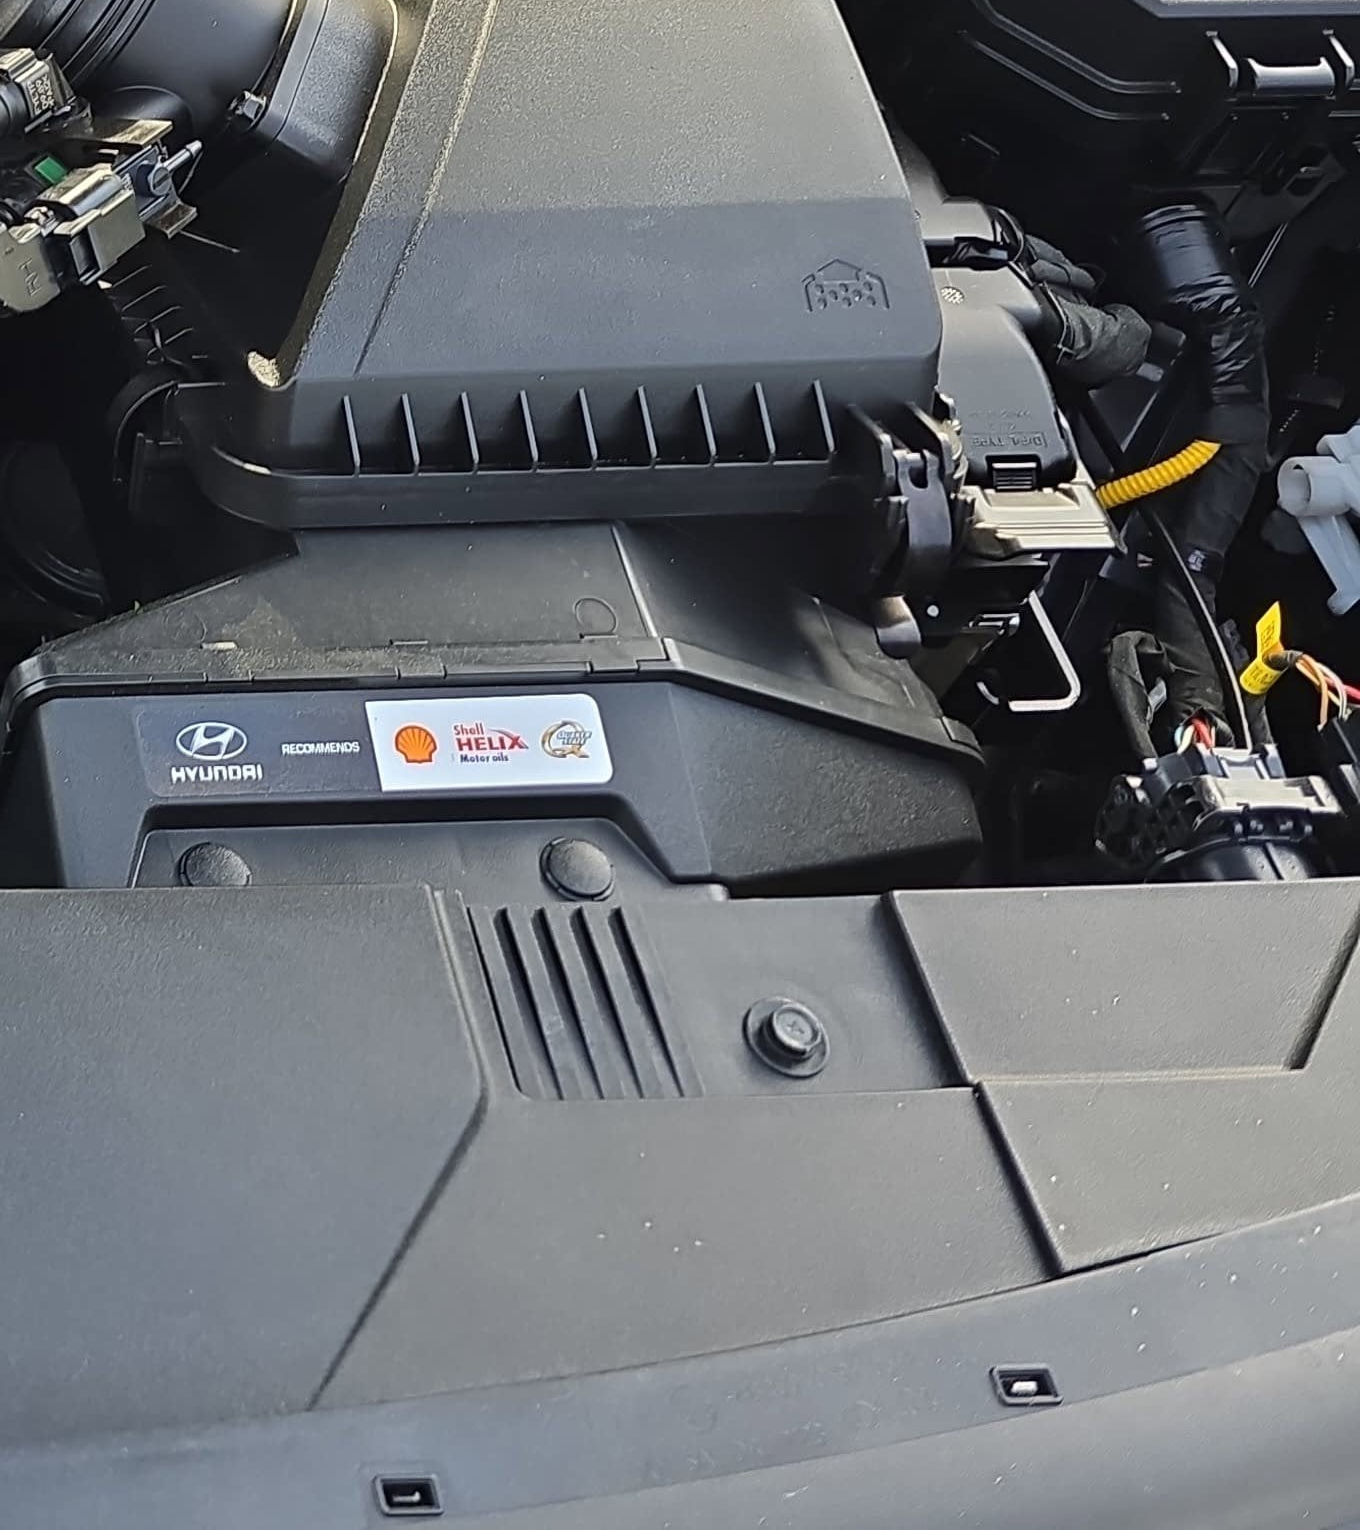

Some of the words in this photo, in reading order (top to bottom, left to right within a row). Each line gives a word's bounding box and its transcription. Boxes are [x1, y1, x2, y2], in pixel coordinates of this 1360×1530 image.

[453, 722, 484, 736] Shell
[282, 741, 361, 757] RECOMMENDS
[457, 735, 528, 751] HELIX
[460, 752, 490, 764] Motor
[492, 753, 509, 763] oils
[170, 764, 264, 784] HYUNDAI
